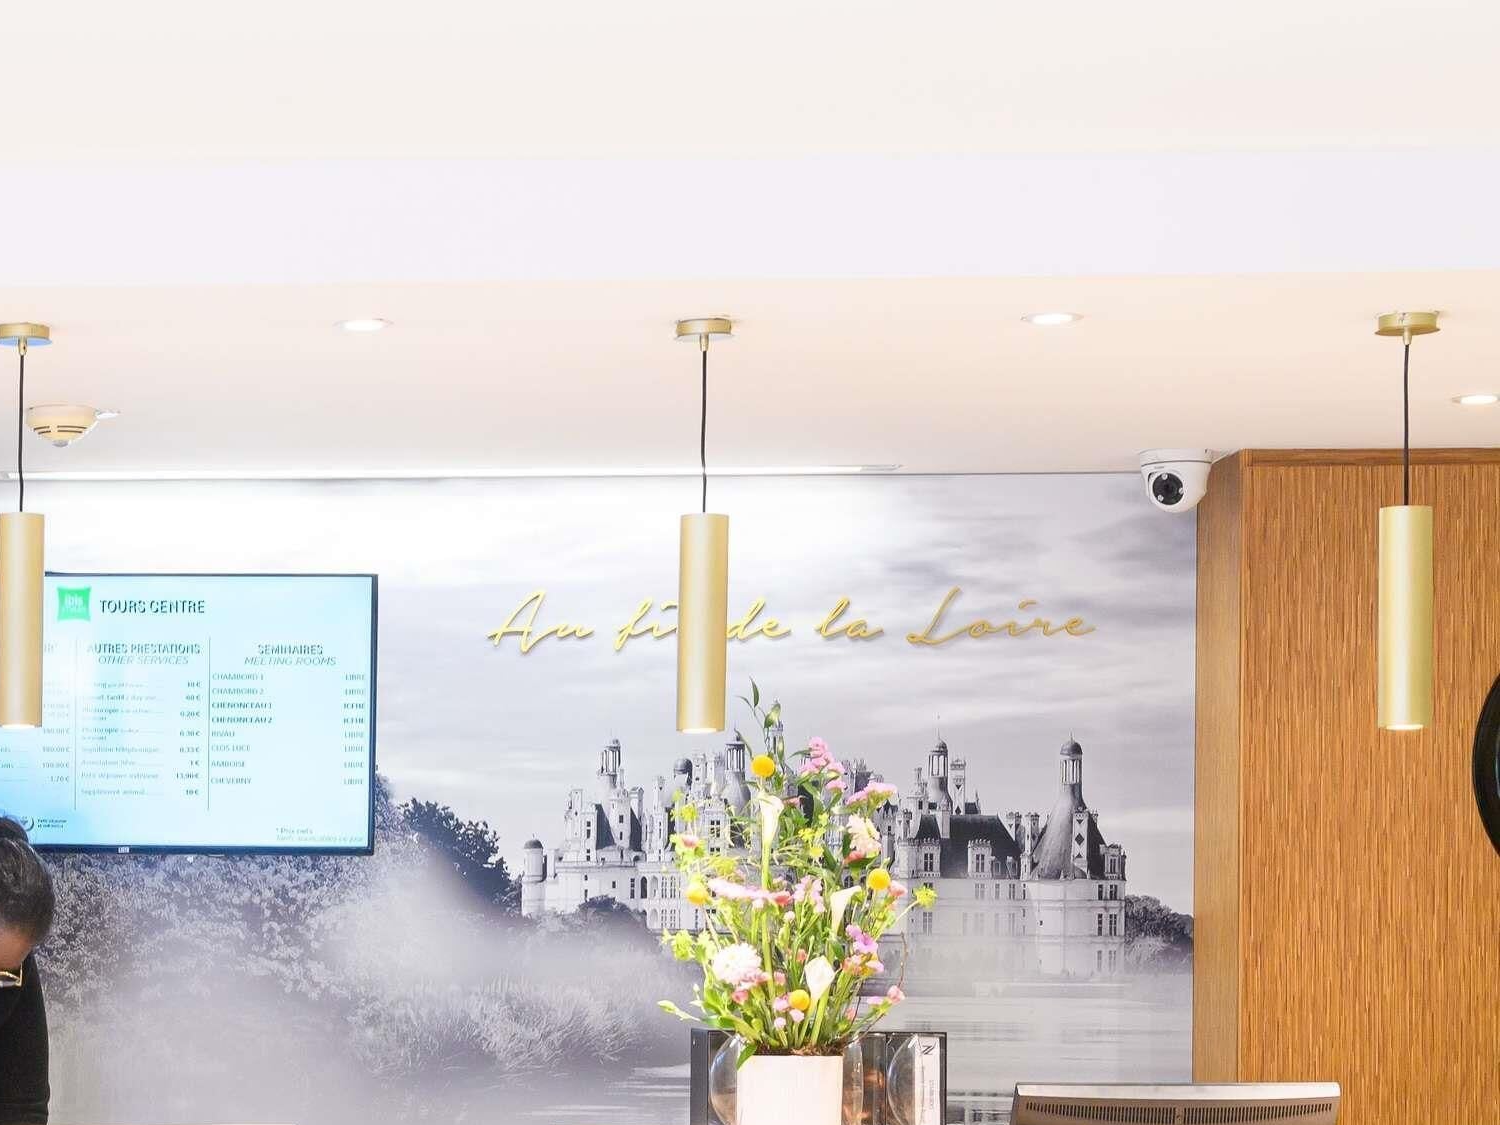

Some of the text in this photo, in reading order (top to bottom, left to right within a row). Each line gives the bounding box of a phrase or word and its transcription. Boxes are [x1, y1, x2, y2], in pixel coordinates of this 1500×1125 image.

[100, 599, 205, 614] TOURS CENTRE
[486, 585, 1097, 655] Au fi de la Loire
[87, 643, 201, 654] AUTRES PRESTATIONS
[98, 655, 189, 665] OTHER SERVICES
[244, 656, 337, 666] MEETING ROOMS
[212, 673, 258, 681] CHAMBORD
[212, 687, 258, 695] CHAMBORD
